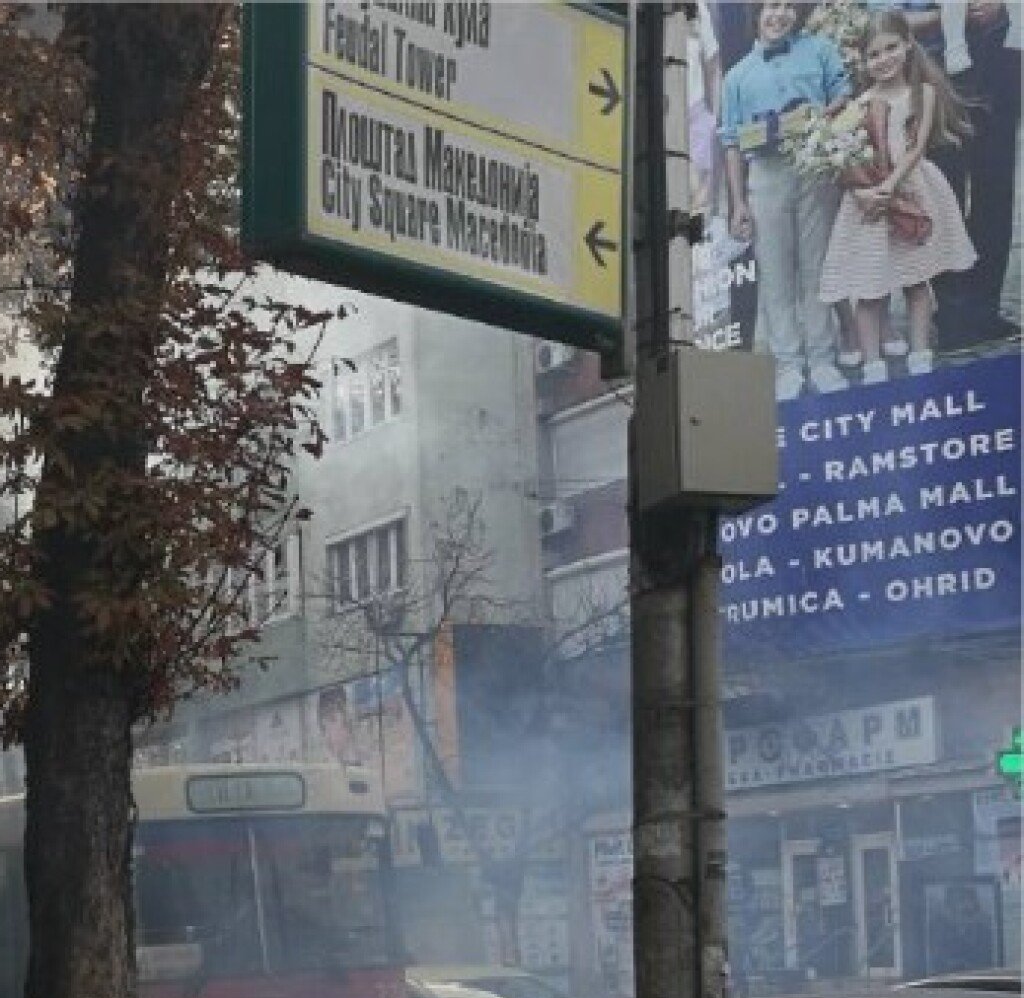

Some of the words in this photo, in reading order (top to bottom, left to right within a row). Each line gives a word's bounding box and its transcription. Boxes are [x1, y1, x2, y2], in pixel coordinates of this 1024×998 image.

[323, 3, 388, 76] Feudal
[394, 29, 457, 101] Tower
[323, 89, 417, 184] Плоштад
[425, 126, 540, 223] Македонија
[322, 158, 362, 231] City
[369, 174, 441, 245] Square
[447, 198, 548, 275] Macedonia
[801, 411, 875, 442] CITY
[892, 389, 986, 426] MALL
[825, 428, 1016, 482] RAMSTORE
[792, 493, 904, 529] PALMA
[920, 475, 1016, 509] MALL
[813, 520, 1013, 568] KUMANOVO
[885, 567, 996, 602] OHRID
